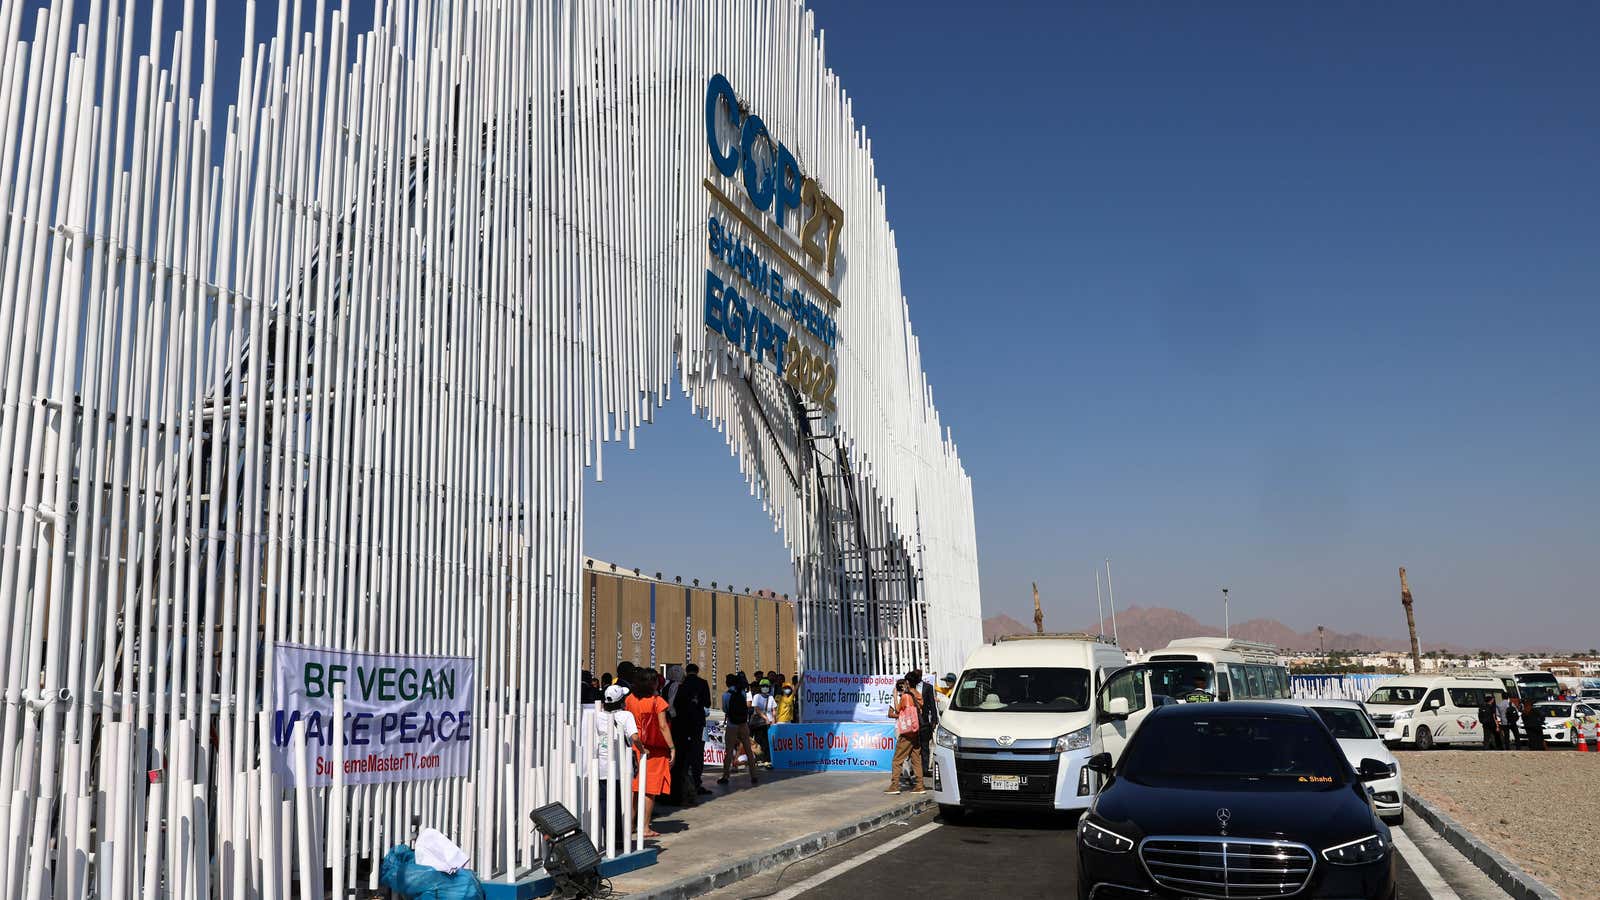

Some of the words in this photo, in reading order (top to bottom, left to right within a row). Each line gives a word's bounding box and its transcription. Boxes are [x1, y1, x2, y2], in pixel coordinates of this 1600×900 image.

[705, 73, 844, 277] COP27
[708, 217, 767, 295] SHARM
[771, 269, 836, 349] EL-SHEIKH
[705, 269, 788, 375] EGYPT
[786, 336, 836, 413] 2022
[304, 662, 347, 699] BE
[357, 666, 455, 701] VEGAN
[860, 677, 874, 686] stop
[875, 677, 894, 687] global
[806, 688, 836, 706] Organic
[838, 688, 871, 707] farming
[380, 710, 471, 745] PEACE
[772, 735, 793, 752] Love
[796, 732, 804, 751] Is
[806, 731, 824, 750] The
[827, 731, 849, 752] Only
[852, 732, 894, 750] Solution
[316, 752, 440, 779] SuemeMasterTV.com
[1309, 775, 1333, 783] Shahd
